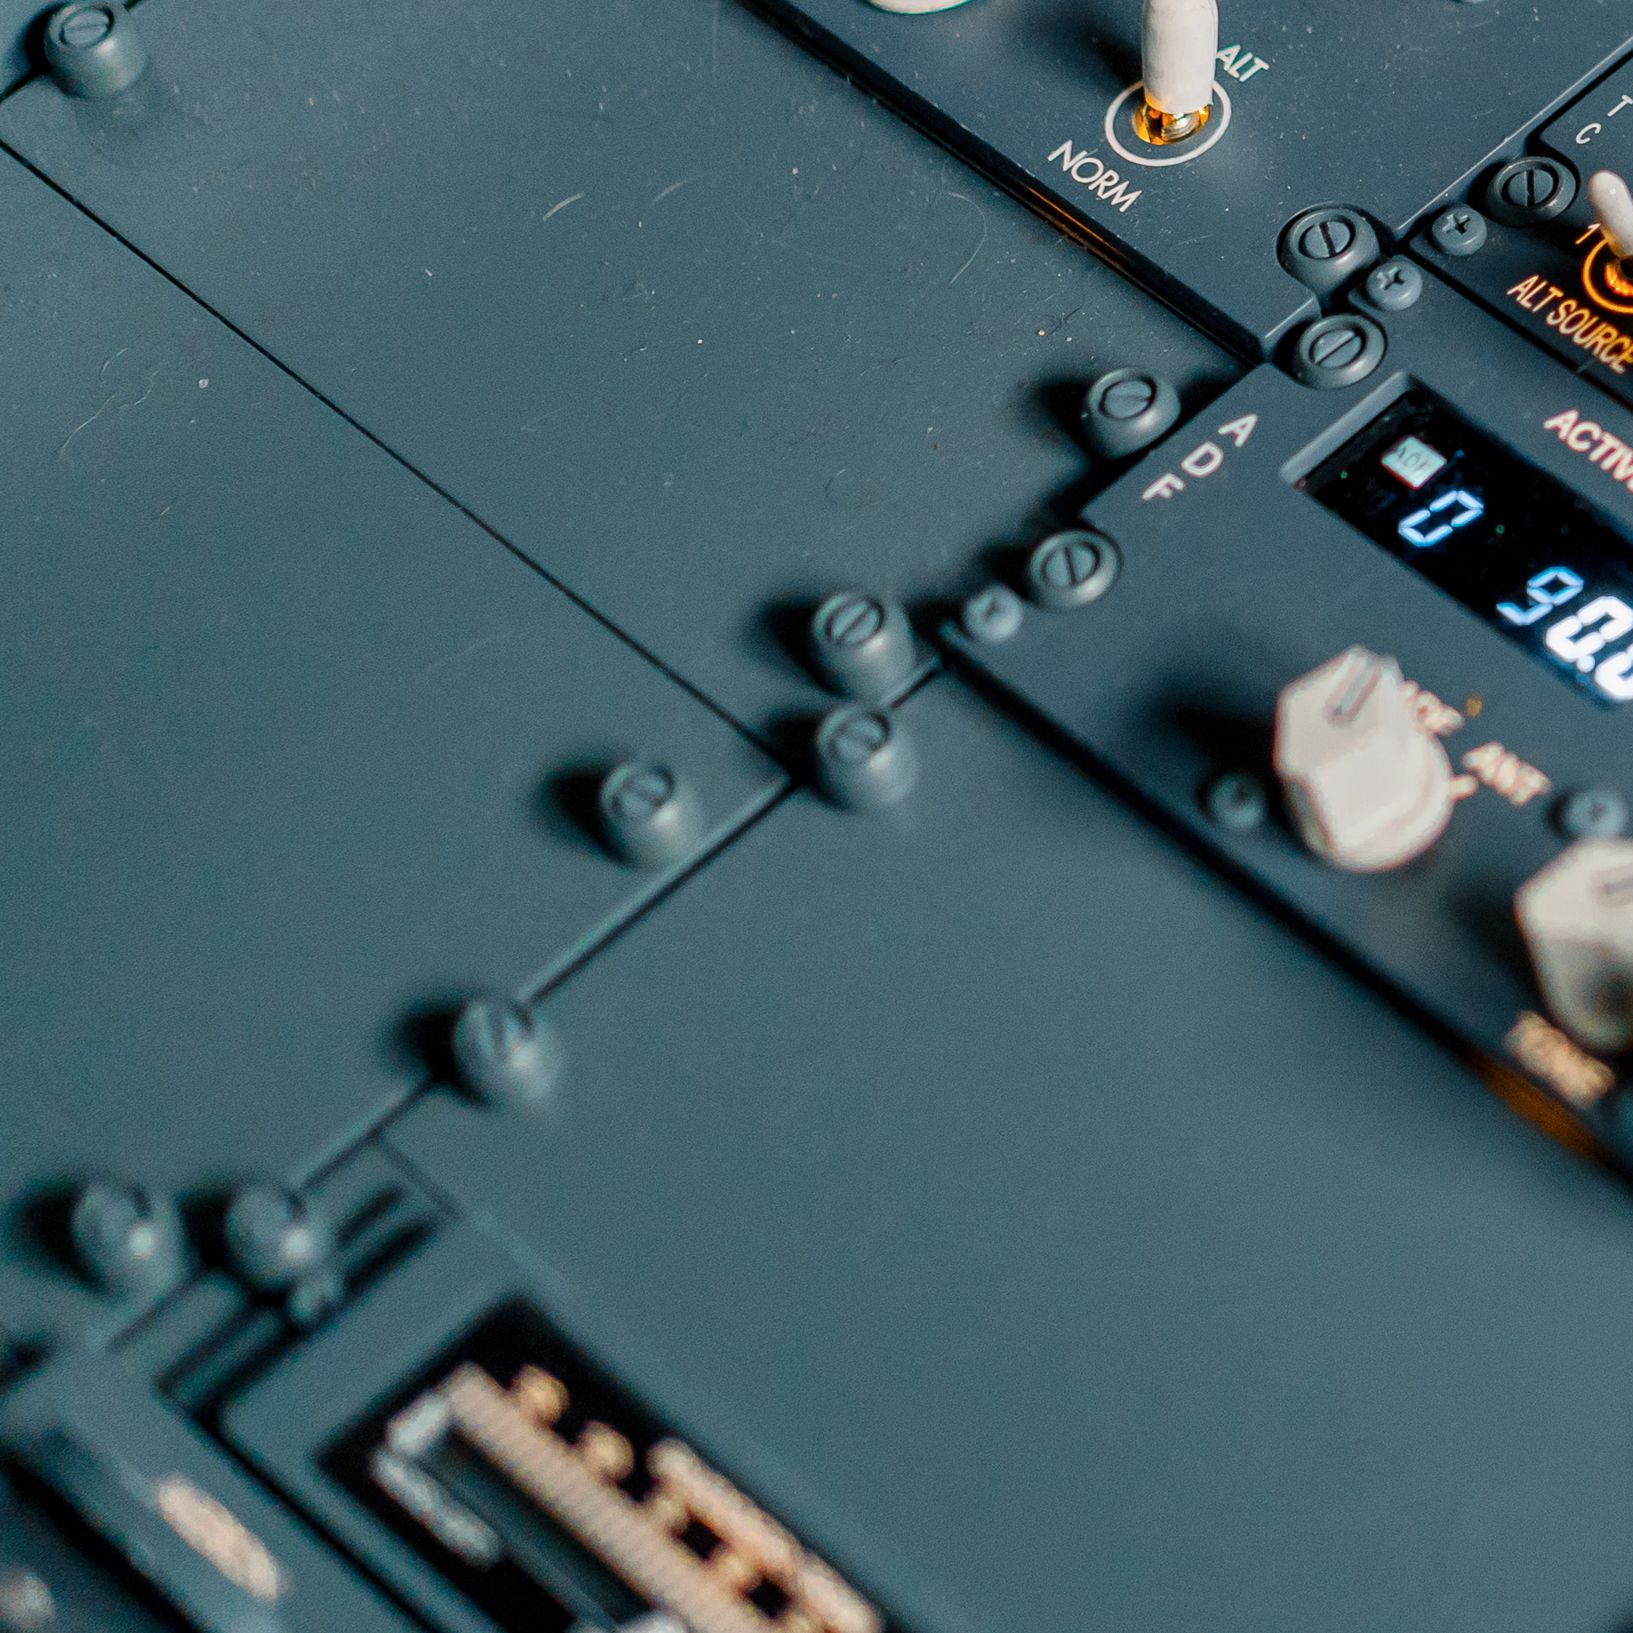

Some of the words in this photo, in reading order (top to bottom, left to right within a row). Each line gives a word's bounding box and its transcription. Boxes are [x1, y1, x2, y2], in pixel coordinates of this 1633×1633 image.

[1216, 44, 1272, 84] ALT
[1045, 139, 1145, 213] NORM
[1506, 274, 1562, 311] ALT
[1141, 413, 1259, 501] ADF
[1398, 489, 1484, 548] 0
